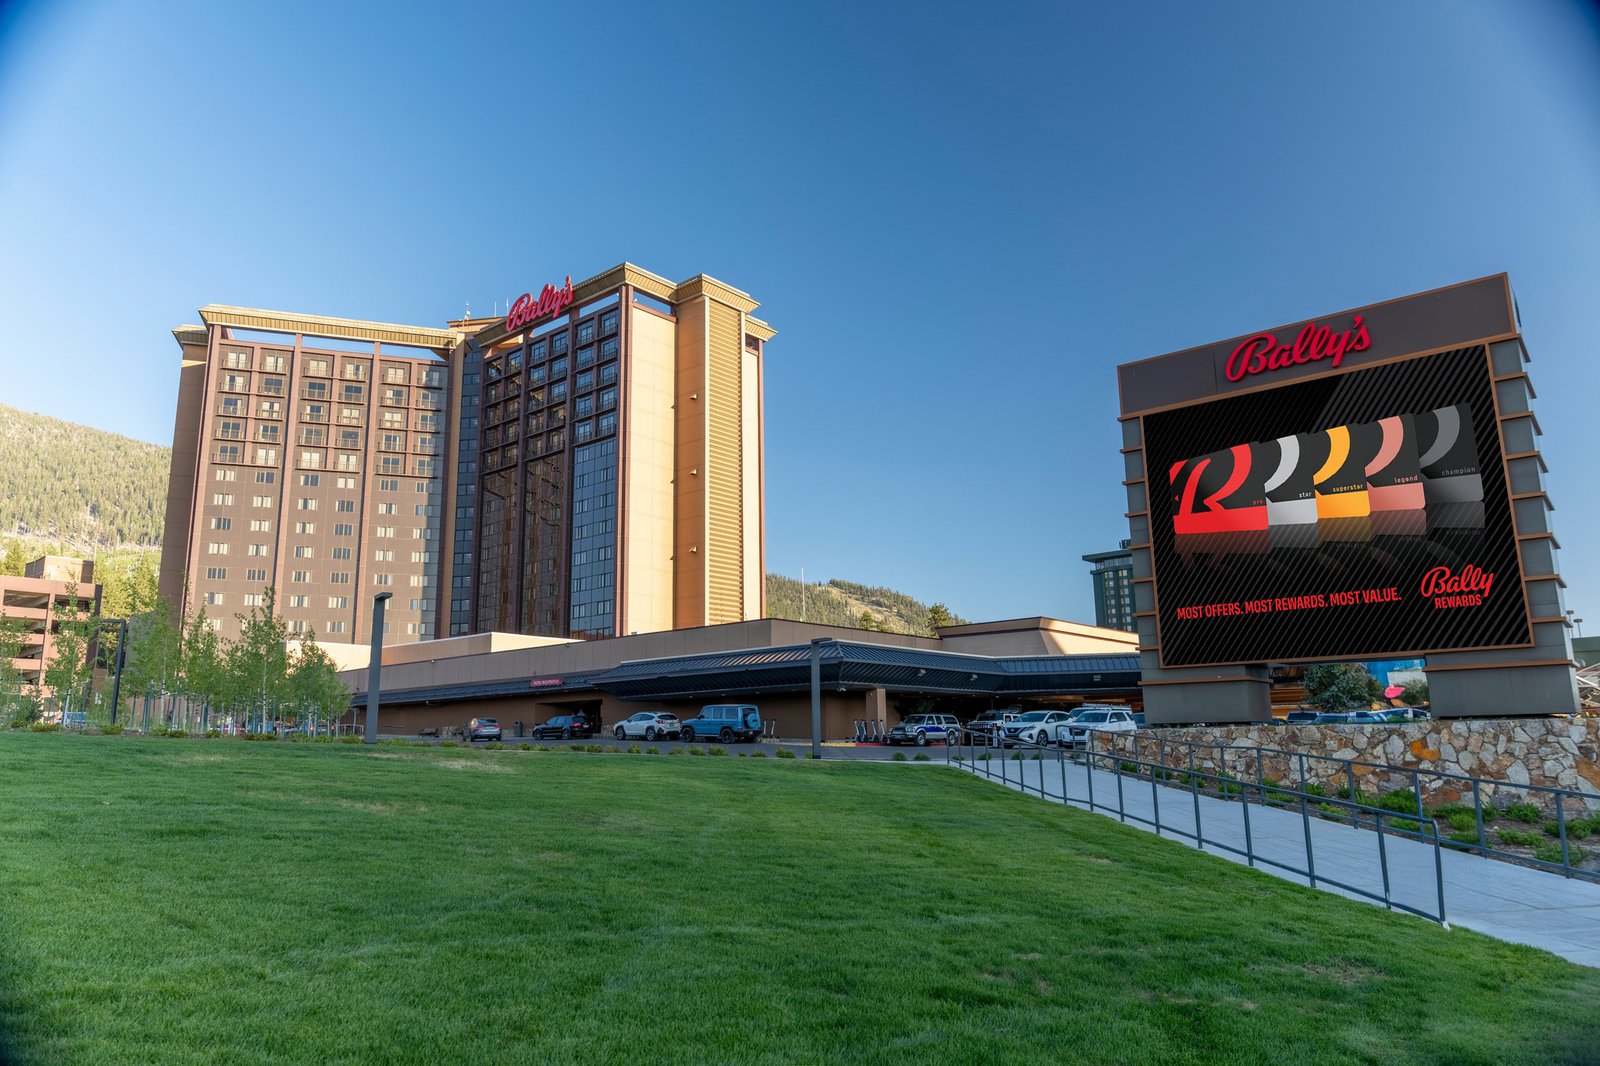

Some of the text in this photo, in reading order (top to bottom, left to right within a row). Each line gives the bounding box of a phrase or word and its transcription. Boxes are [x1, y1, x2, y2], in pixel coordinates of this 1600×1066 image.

[506, 276, 574, 331] Bally's
[1225, 314, 1371, 381] Bally's
[1394, 473, 1419, 484] legend
[1441, 465, 1476, 478] champion
[1332, 482, 1364, 493] superstar
[1298, 491, 1313, 499] star
[1252, 498, 1264, 507] pro
[1420, 564, 1495, 597] Bally
[1176, 587, 1402, 621] MOST OFFERS. MOST REWARDS. MOST VALUE.
[1434, 594, 1483, 609] REWARDS
